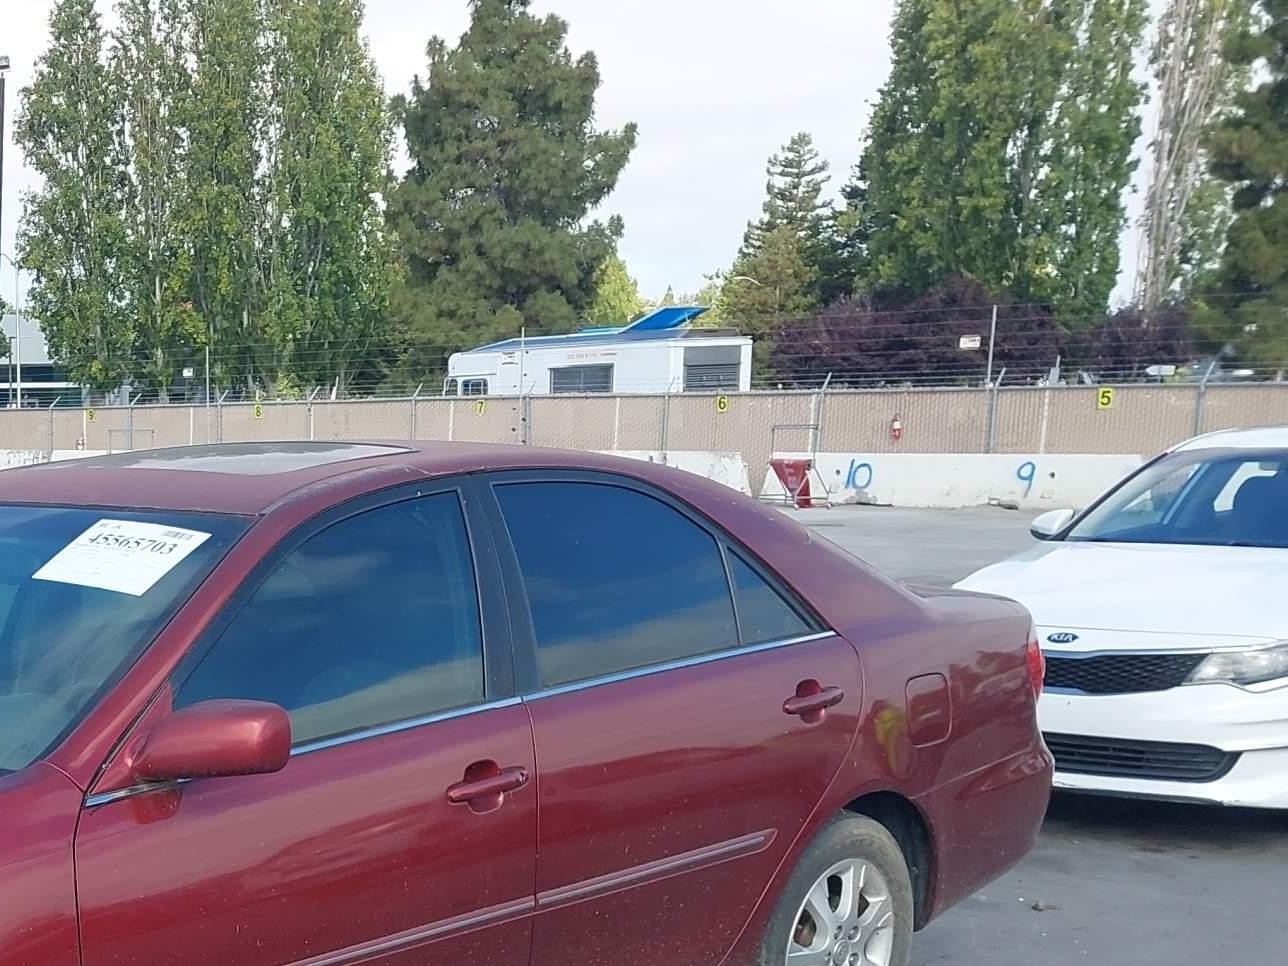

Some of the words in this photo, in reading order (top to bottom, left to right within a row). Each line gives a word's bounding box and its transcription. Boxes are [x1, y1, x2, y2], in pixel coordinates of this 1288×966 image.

[718, 396, 727, 410] 6
[1100, 390, 1111, 406] 5
[255, 406, 262, 417] 8
[477, 401, 484, 413] 7
[844, 458, 873, 490] 10
[1016, 461, 1036, 499] 9
[88, 533, 178, 555] 45565703
[1049, 633, 1075, 642] KIA
